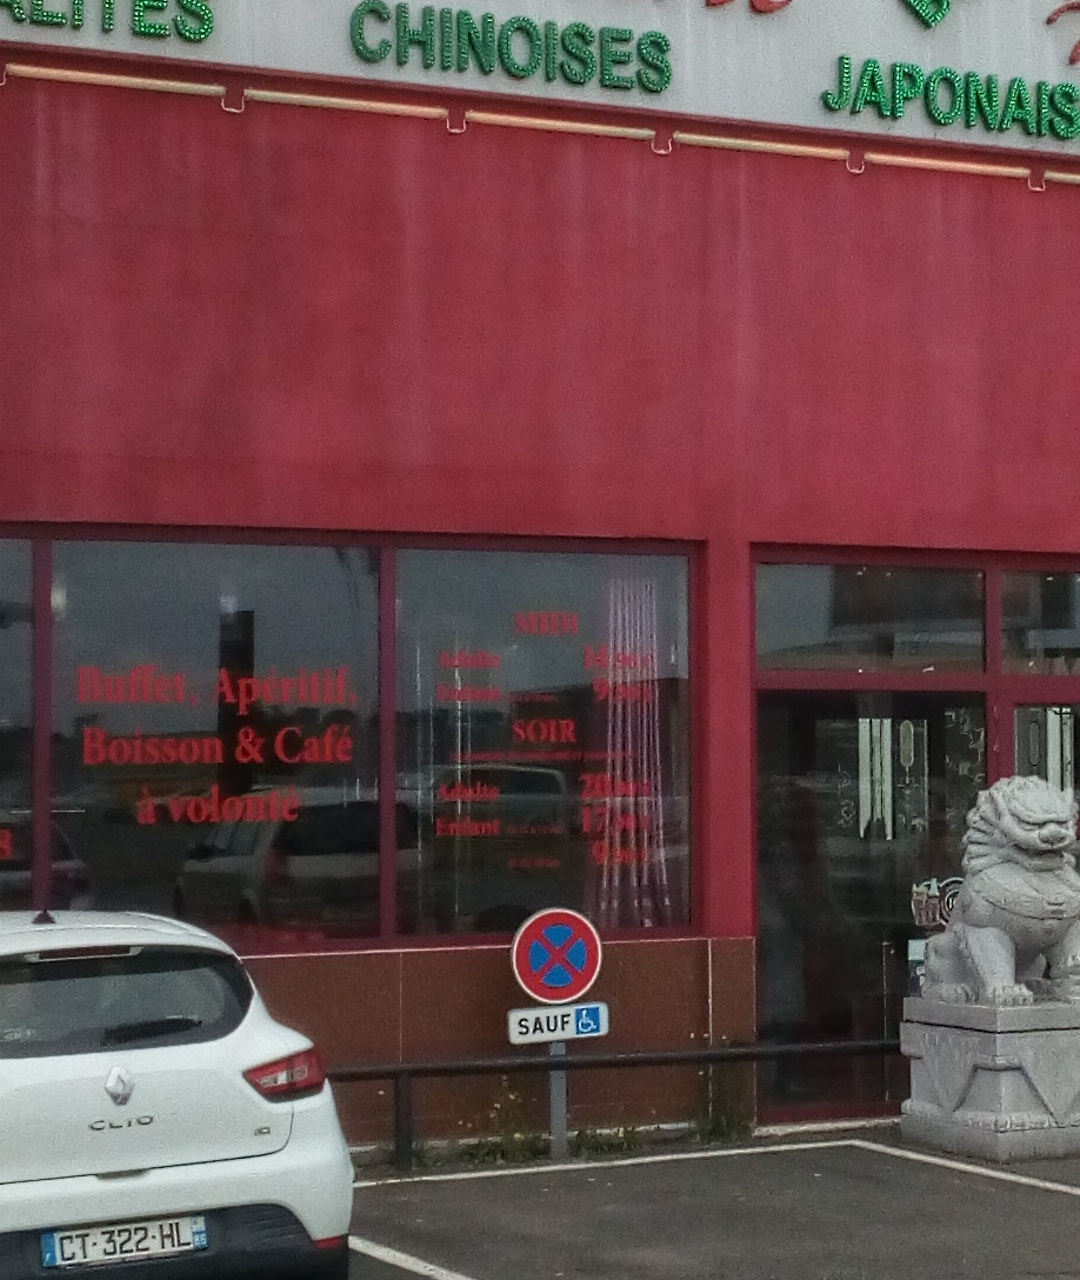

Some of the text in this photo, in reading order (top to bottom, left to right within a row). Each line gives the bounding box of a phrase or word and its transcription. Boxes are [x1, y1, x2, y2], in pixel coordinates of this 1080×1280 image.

[83, 724, 353, 765] Boisson & Café
[512, 719, 577, 744] SOIR
[169, 783, 301, 825] volonté
[518, 1013, 572, 1036] SAUF
